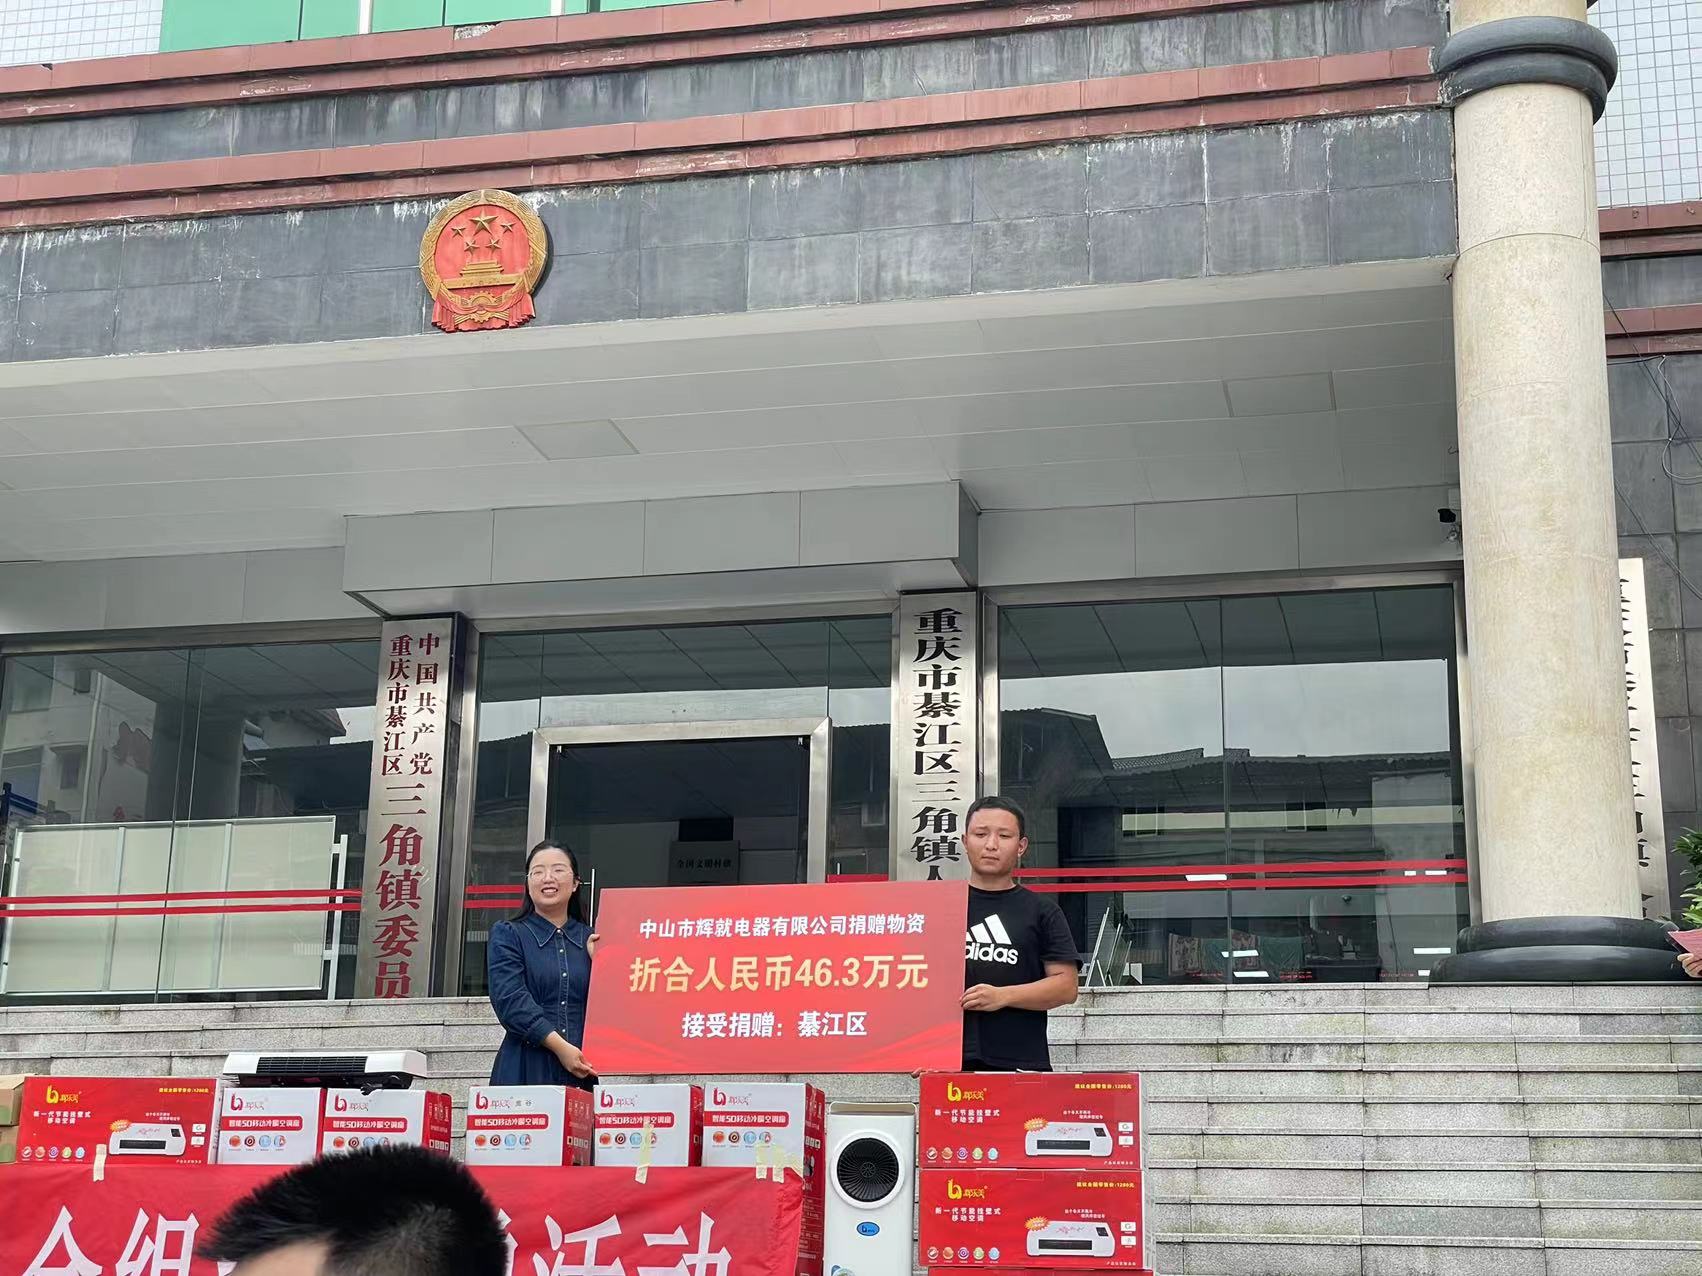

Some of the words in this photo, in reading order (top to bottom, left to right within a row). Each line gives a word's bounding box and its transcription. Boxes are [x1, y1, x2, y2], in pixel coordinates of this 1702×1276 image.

[381, 634, 414, 777] 重庆市綦江区
[410, 632, 441, 776] 中国共产党
[373, 783, 427, 999] 三角镇委员
[639, 912, 925, 939] 中山市辉就电器有限公司捐赠物资
[965, 942, 1019, 965] didas
[628, 953, 930, 993] 折合人民币46.3万元
[681, 1010, 868, 1039] 接受捐赠：綦江区
[951, 1115, 984, 1124] 移动空调
[951, 1214, 985, 1223] 移动空调
